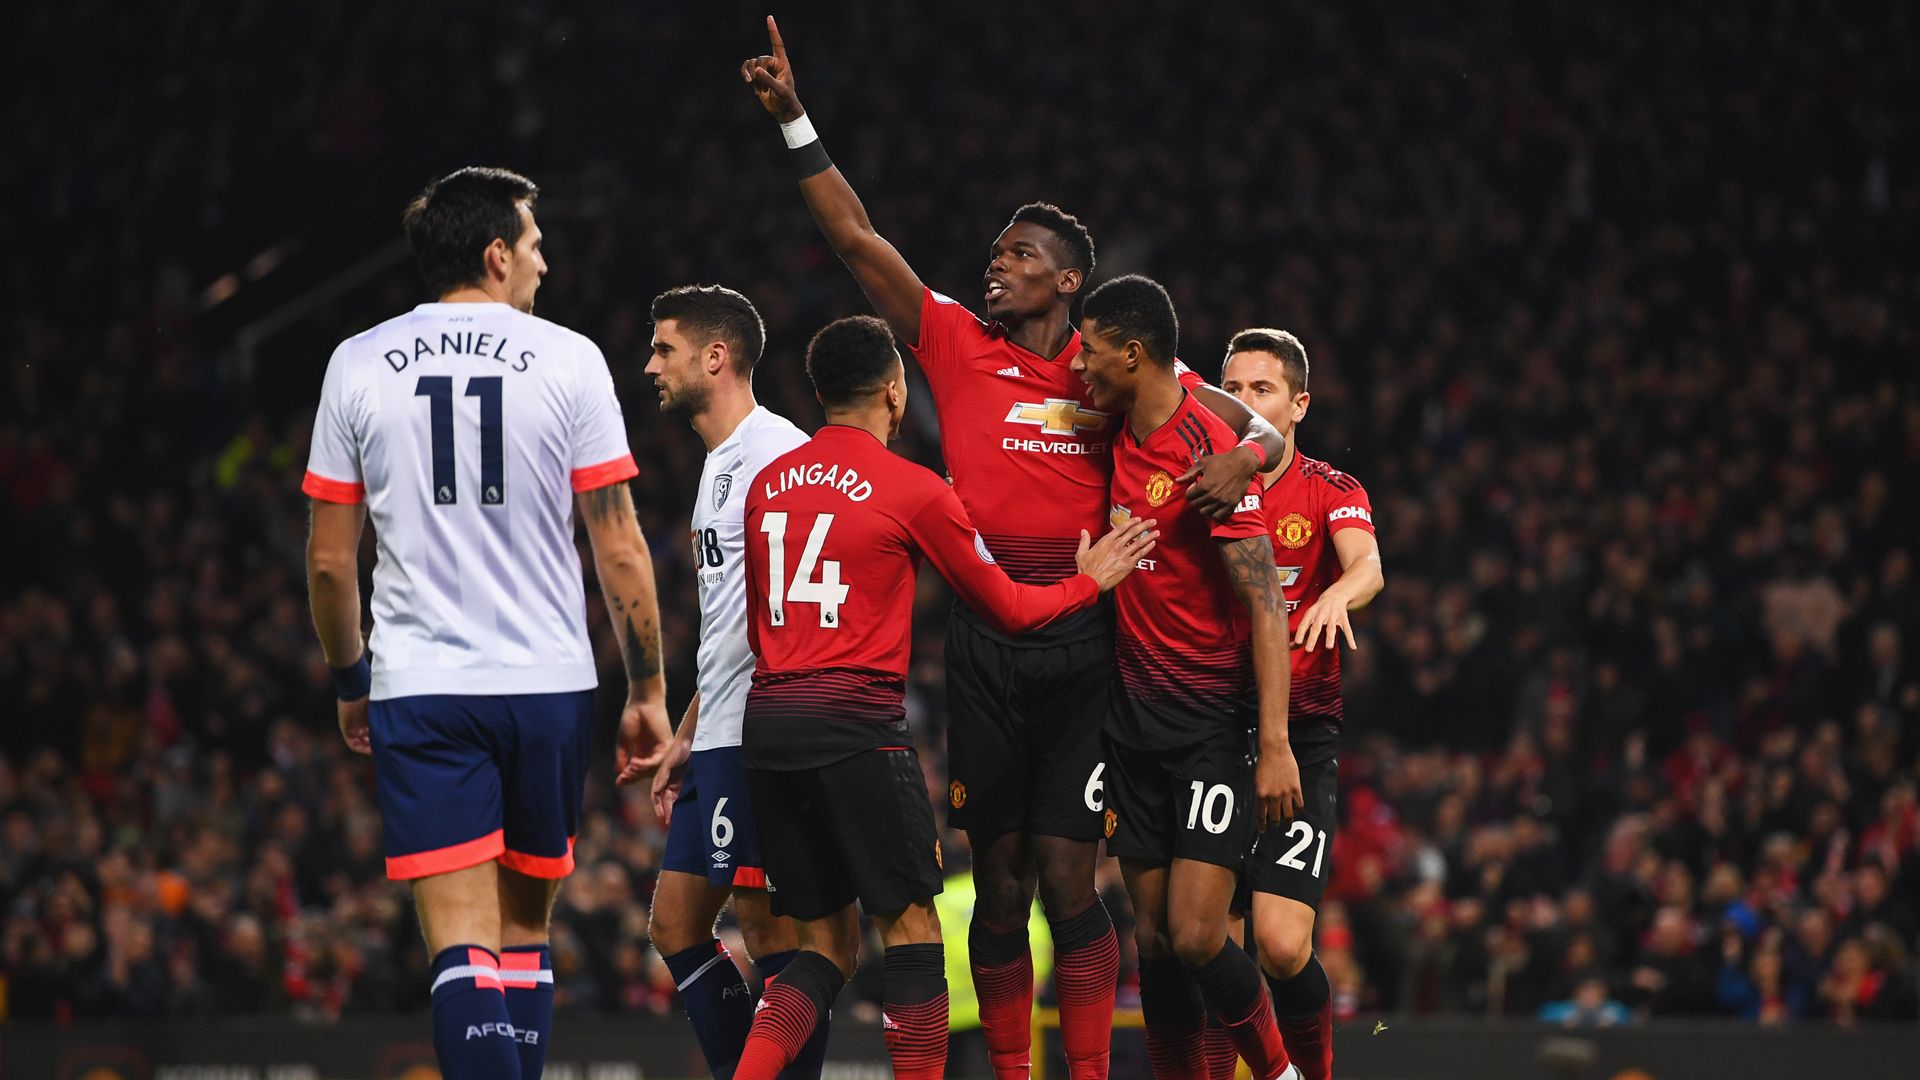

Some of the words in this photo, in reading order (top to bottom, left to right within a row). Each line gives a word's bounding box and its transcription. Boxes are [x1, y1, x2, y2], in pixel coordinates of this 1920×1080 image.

[384, 332, 535, 373] DANIELS
[414, 375, 504, 505] 11
[1002, 437, 1108, 455] CHEVROLET
[765, 463, 873, 502] LINGARD
[1234, 494, 1260, 513] LER
[760, 511, 850, 628] 14
[1135, 558, 1157, 571] ET
[1084, 762, 1105, 812] 6
[1187, 780, 1235, 834] 10
[711, 797, 734, 848] 6
[1275, 820, 1327, 879] 21
